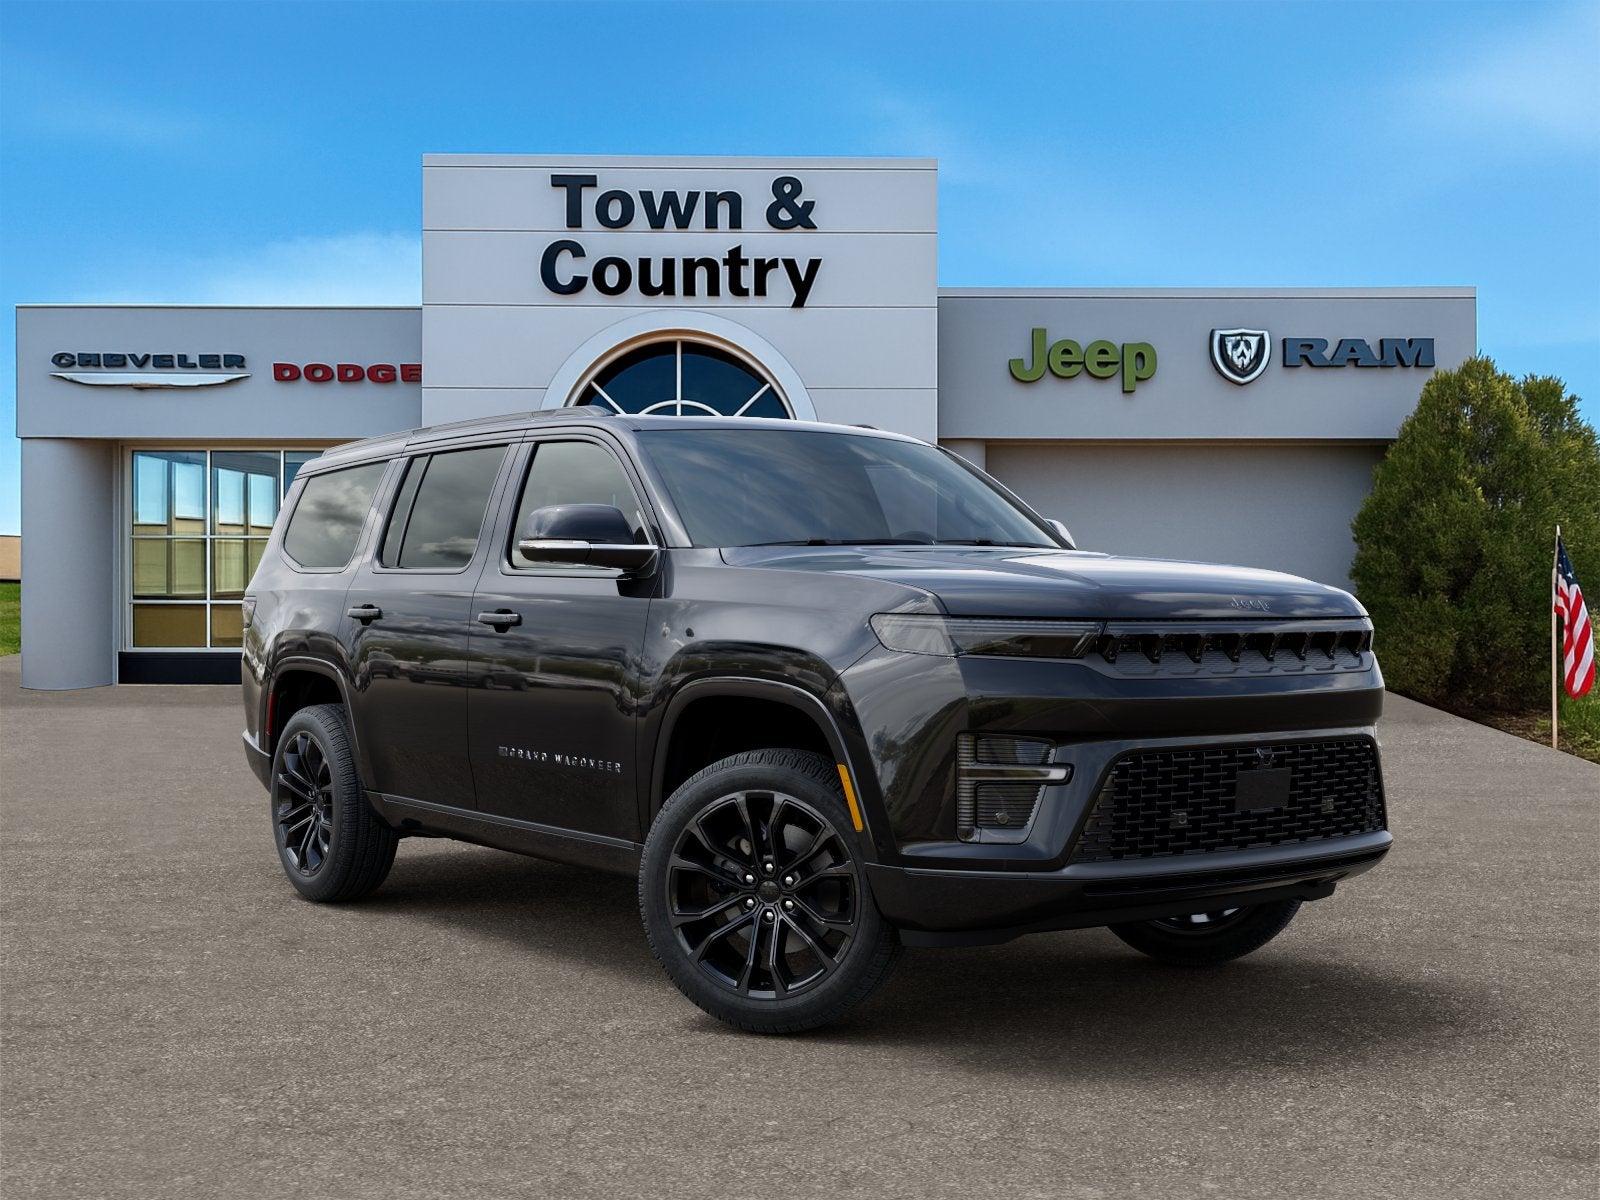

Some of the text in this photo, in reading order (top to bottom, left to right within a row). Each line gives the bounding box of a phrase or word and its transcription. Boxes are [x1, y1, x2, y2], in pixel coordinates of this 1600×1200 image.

[550, 174, 818, 230] Town &
[540, 239, 822, 308] Country
[273, 362, 422, 383] DODGE
[1009, 328, 1157, 392] Jeep
[1282, 337, 1436, 368] RAM
[509, 747, 621, 773] GRAND WAGONEER
